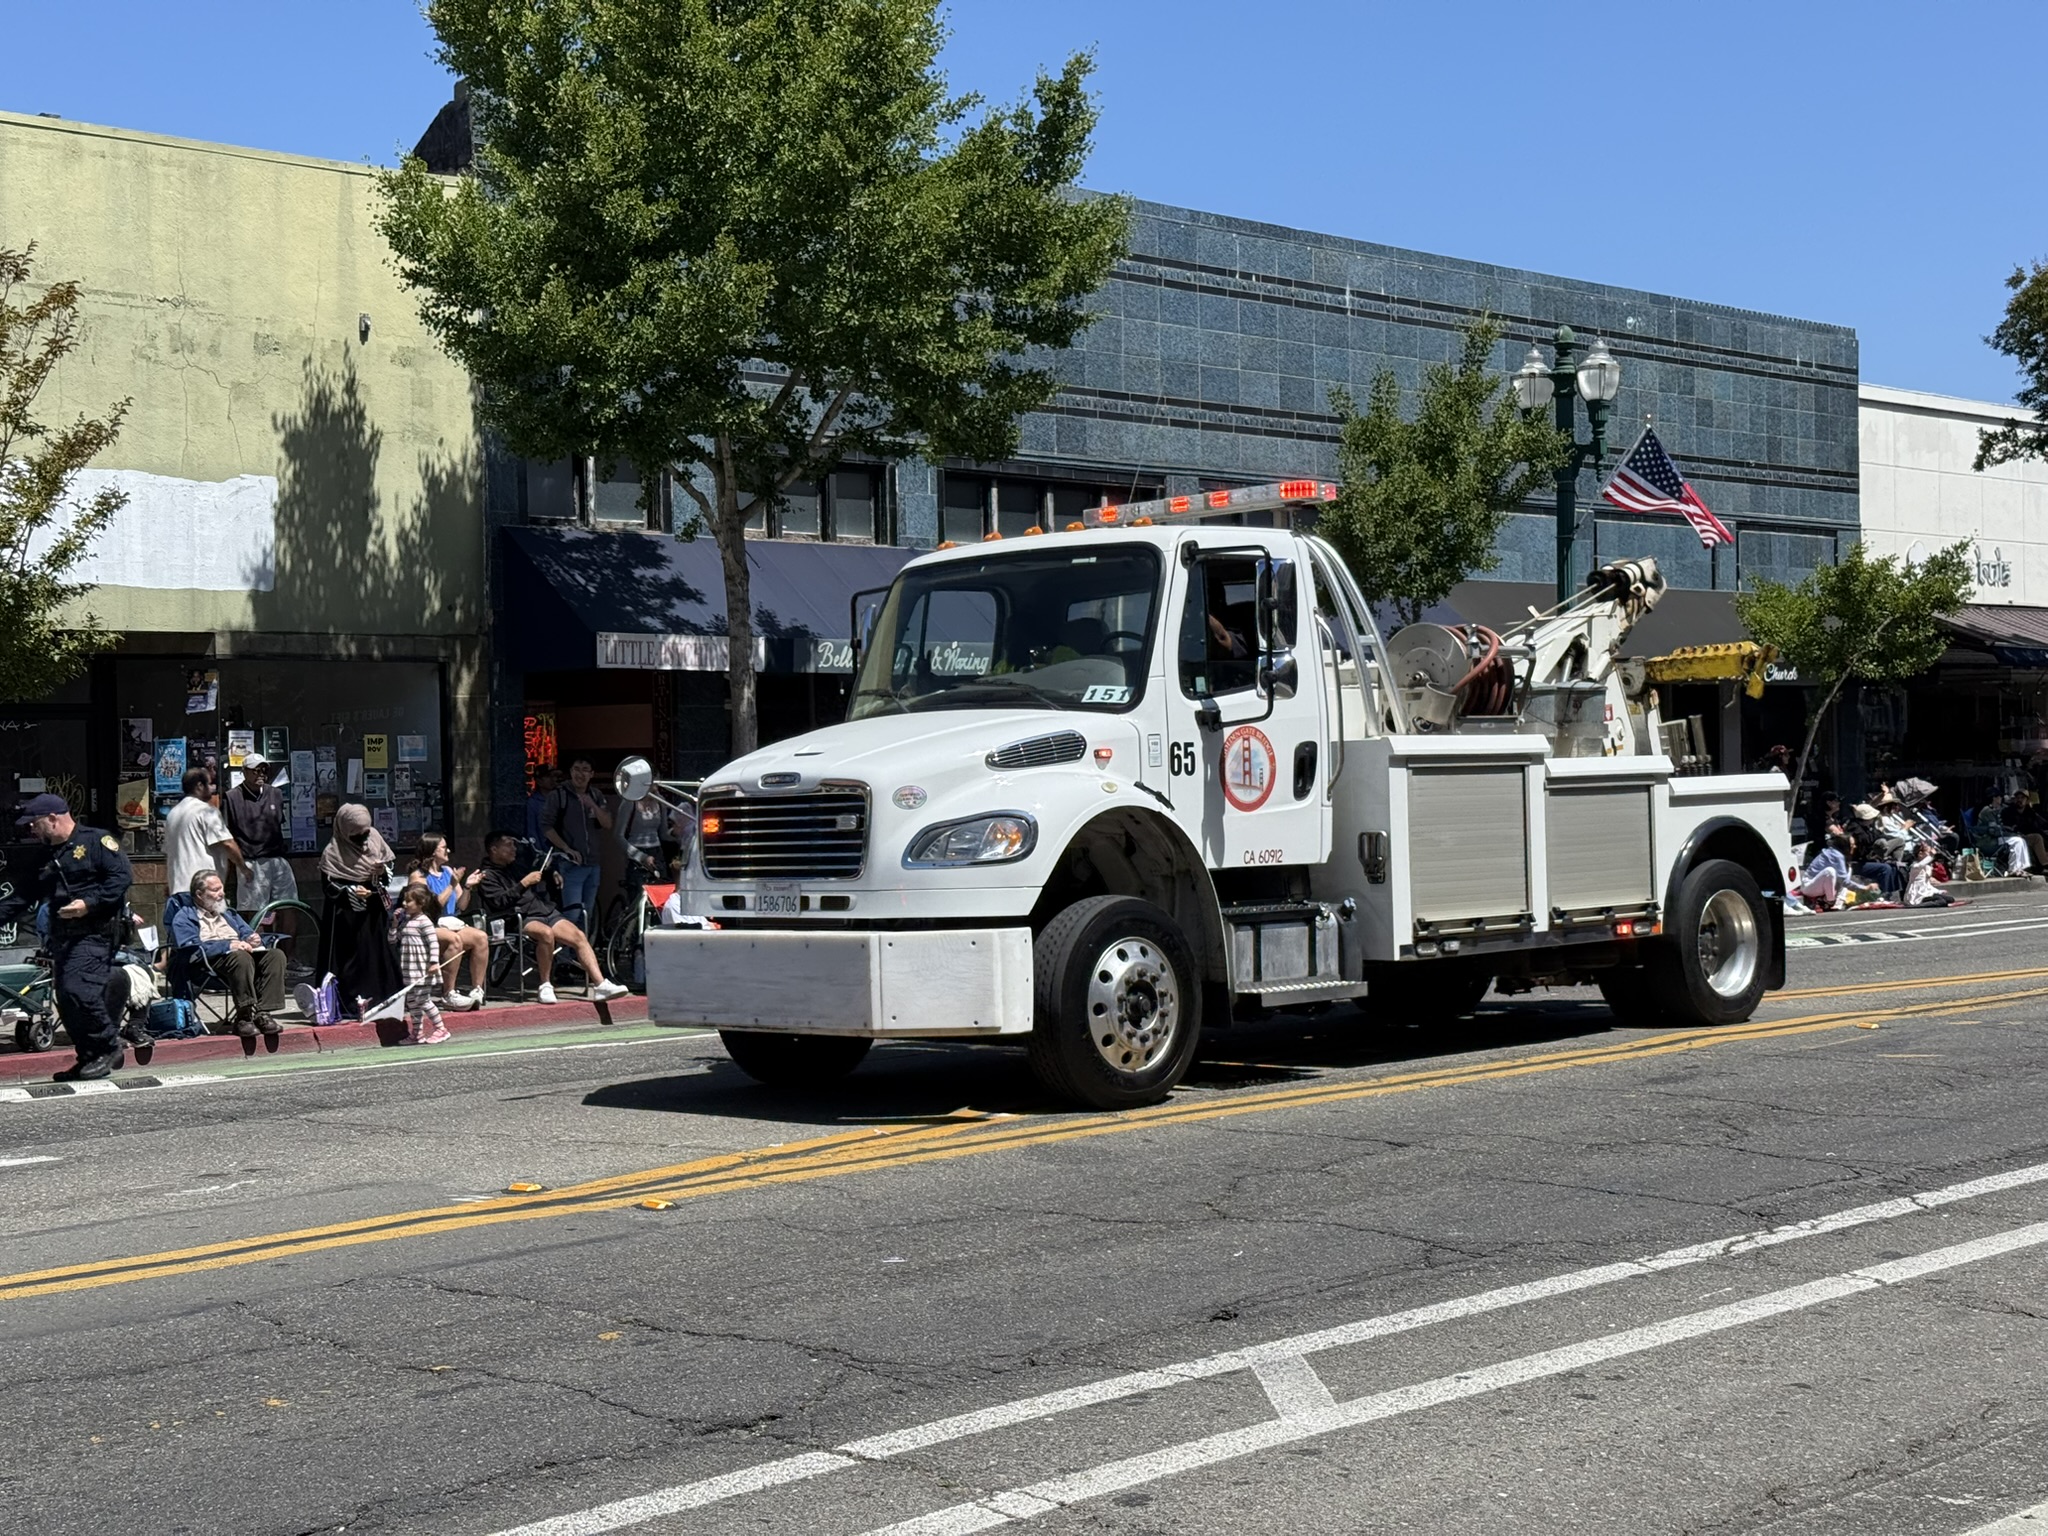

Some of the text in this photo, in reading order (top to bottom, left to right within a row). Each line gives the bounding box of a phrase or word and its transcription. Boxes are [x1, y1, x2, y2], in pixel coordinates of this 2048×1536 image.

[604, 639, 656, 666] LITTLE
[931, 645, 943, 670] &
[944, 647, 990, 675] Waxing
[1084, 688, 1129, 701] 151
[367, 737, 384, 745] IMP
[1170, 741, 1195, 776] 65
[1243, 849, 1283, 864] CA 60912
[757, 895, 797, 912] 1586706
